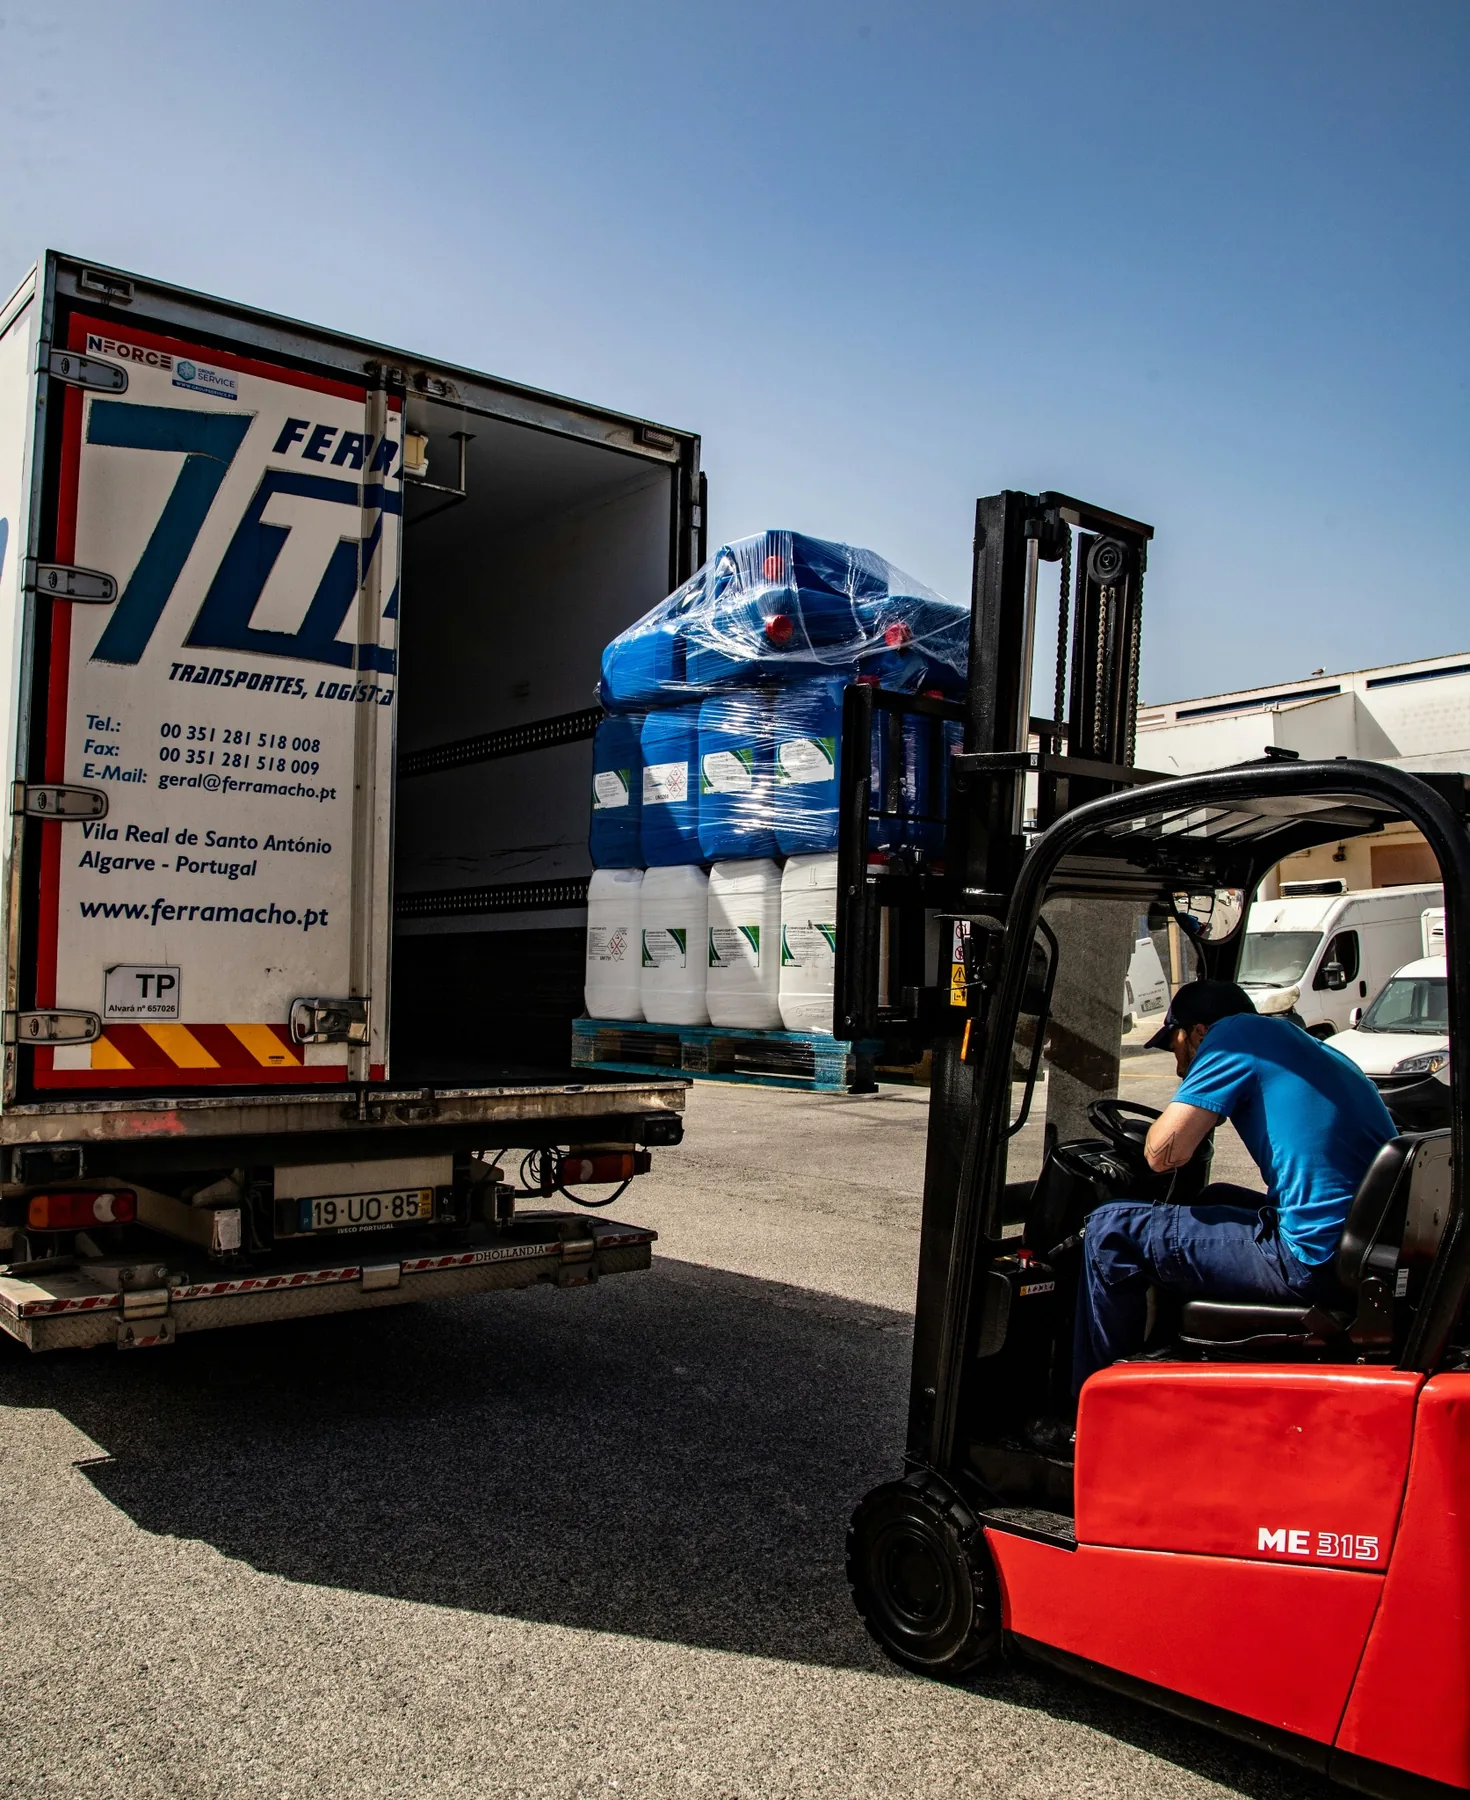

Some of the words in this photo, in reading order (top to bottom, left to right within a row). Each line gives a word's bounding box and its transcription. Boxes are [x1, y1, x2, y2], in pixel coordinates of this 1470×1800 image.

[89, 336, 172, 369] NFORCE
[198, 373, 235, 389] SERVICE
[86, 714, 121, 733] Tel.:
[160, 723, 181, 738] 00
[186, 726, 216, 742] 351
[222, 729, 251, 745] 281
[257, 733, 287, 750] 518
[292, 737, 320, 753] 008
[83, 739, 120, 757] Fax:
[159, 747, 180, 762] 00
[185, 749, 215, 765] 351
[221, 753, 250, 769] 281
[256, 756, 286, 773] 518
[291, 760, 320, 775] 009
[82, 763, 147, 784] E-Mail:
[158, 773, 337, 803] geral@ferramacho.pt
[81, 822, 118, 841] Vila
[125, 825, 169, 844] Real
[175, 828, 198, 845] de
[204, 831, 258, 850] Santo
[263, 835, 332, 853] António
[78, 851, 155, 874] Algarve
[176, 856, 257, 880] Portugal
[80, 898, 329, 931] www.ferramacho.pt
[136, 974, 176, 998] TP
[108, 1004, 135, 1012] Alvará
[147, 1004, 176, 1012] 657026
[337, 1226, 357, 1234] IVECO
[358, 1223, 394, 1232] PORTUGAL
[475, 1245, 545, 1262] DHOLLANDIA
[1257, 1527, 1310, 1555] ME
[1316, 1532, 1379, 1561] 315
